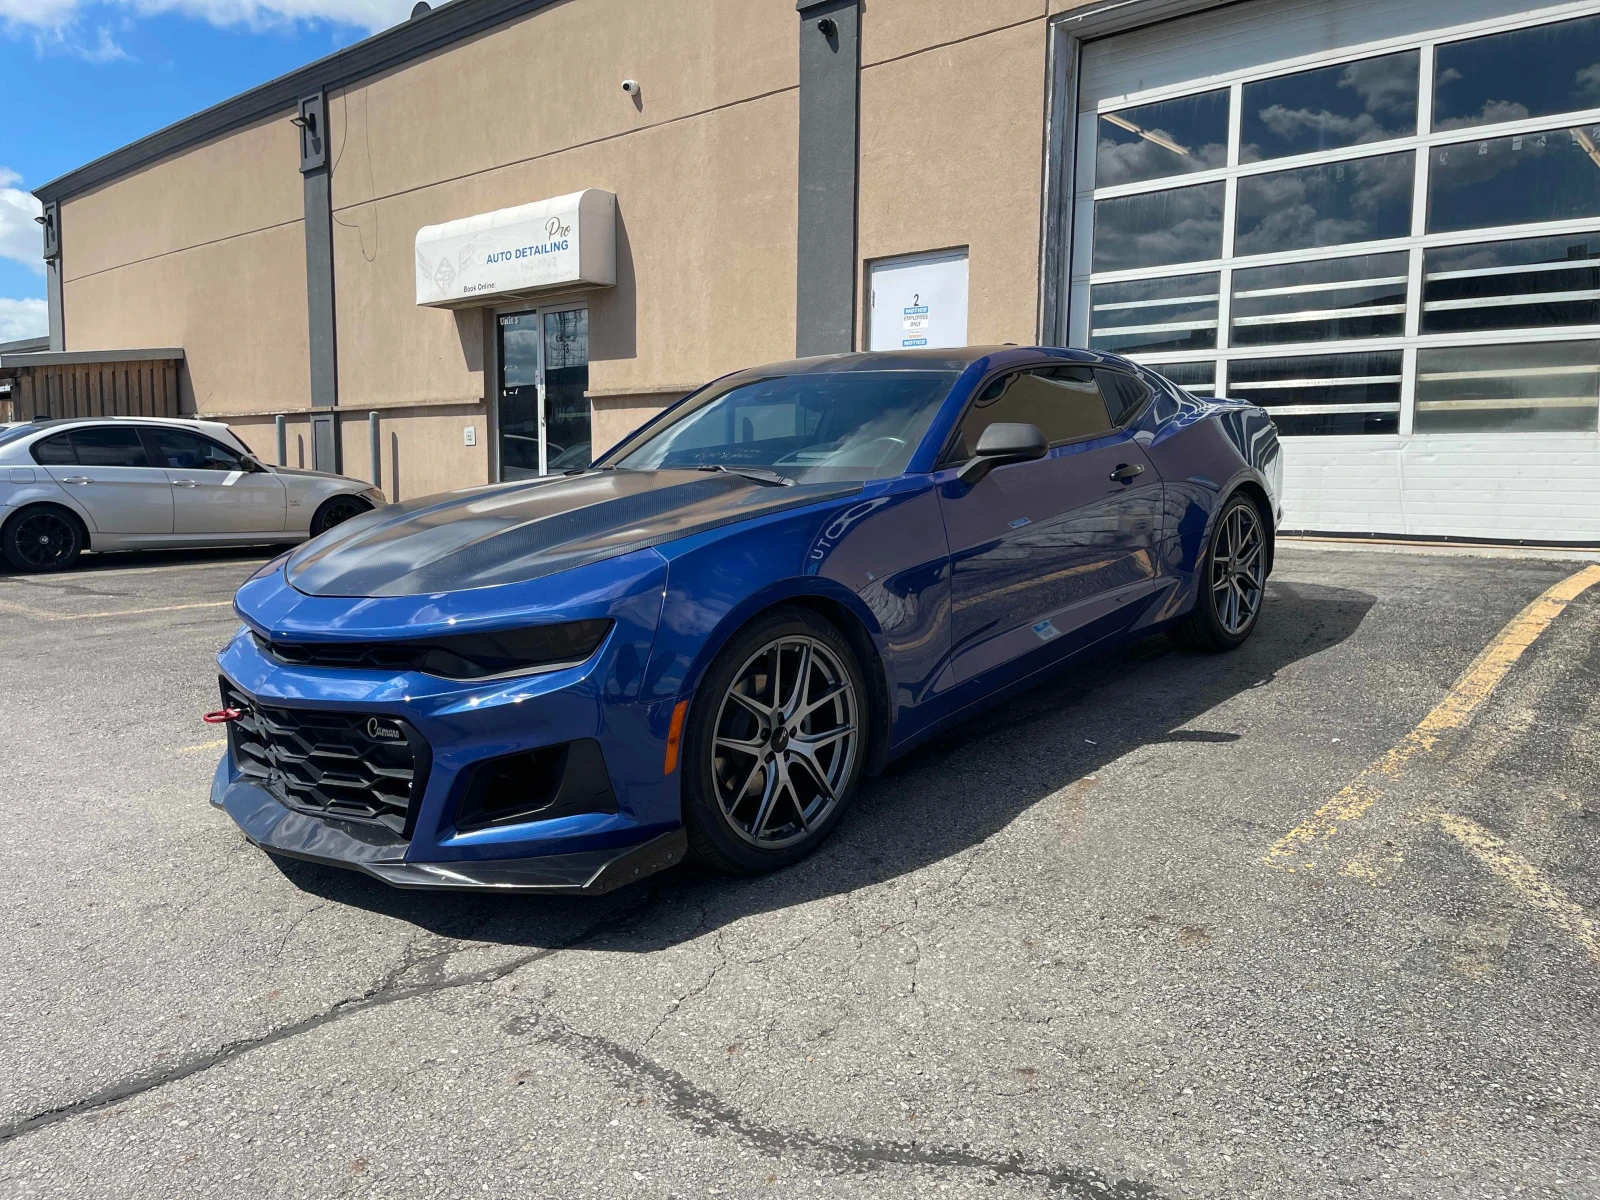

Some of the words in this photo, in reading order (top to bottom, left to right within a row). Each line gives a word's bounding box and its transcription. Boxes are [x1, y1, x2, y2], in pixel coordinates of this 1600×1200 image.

[545, 216, 571, 240] Pro
[486, 250, 512, 264] AUTO
[515, 240, 569, 259] DETAILING
[463, 284, 477, 293] Book
[477, 281, 497, 291] Online:
[913, 293, 920, 307] 2
[499, 315, 514, 326] Unit
[367, 717, 400, 739] Camaro
